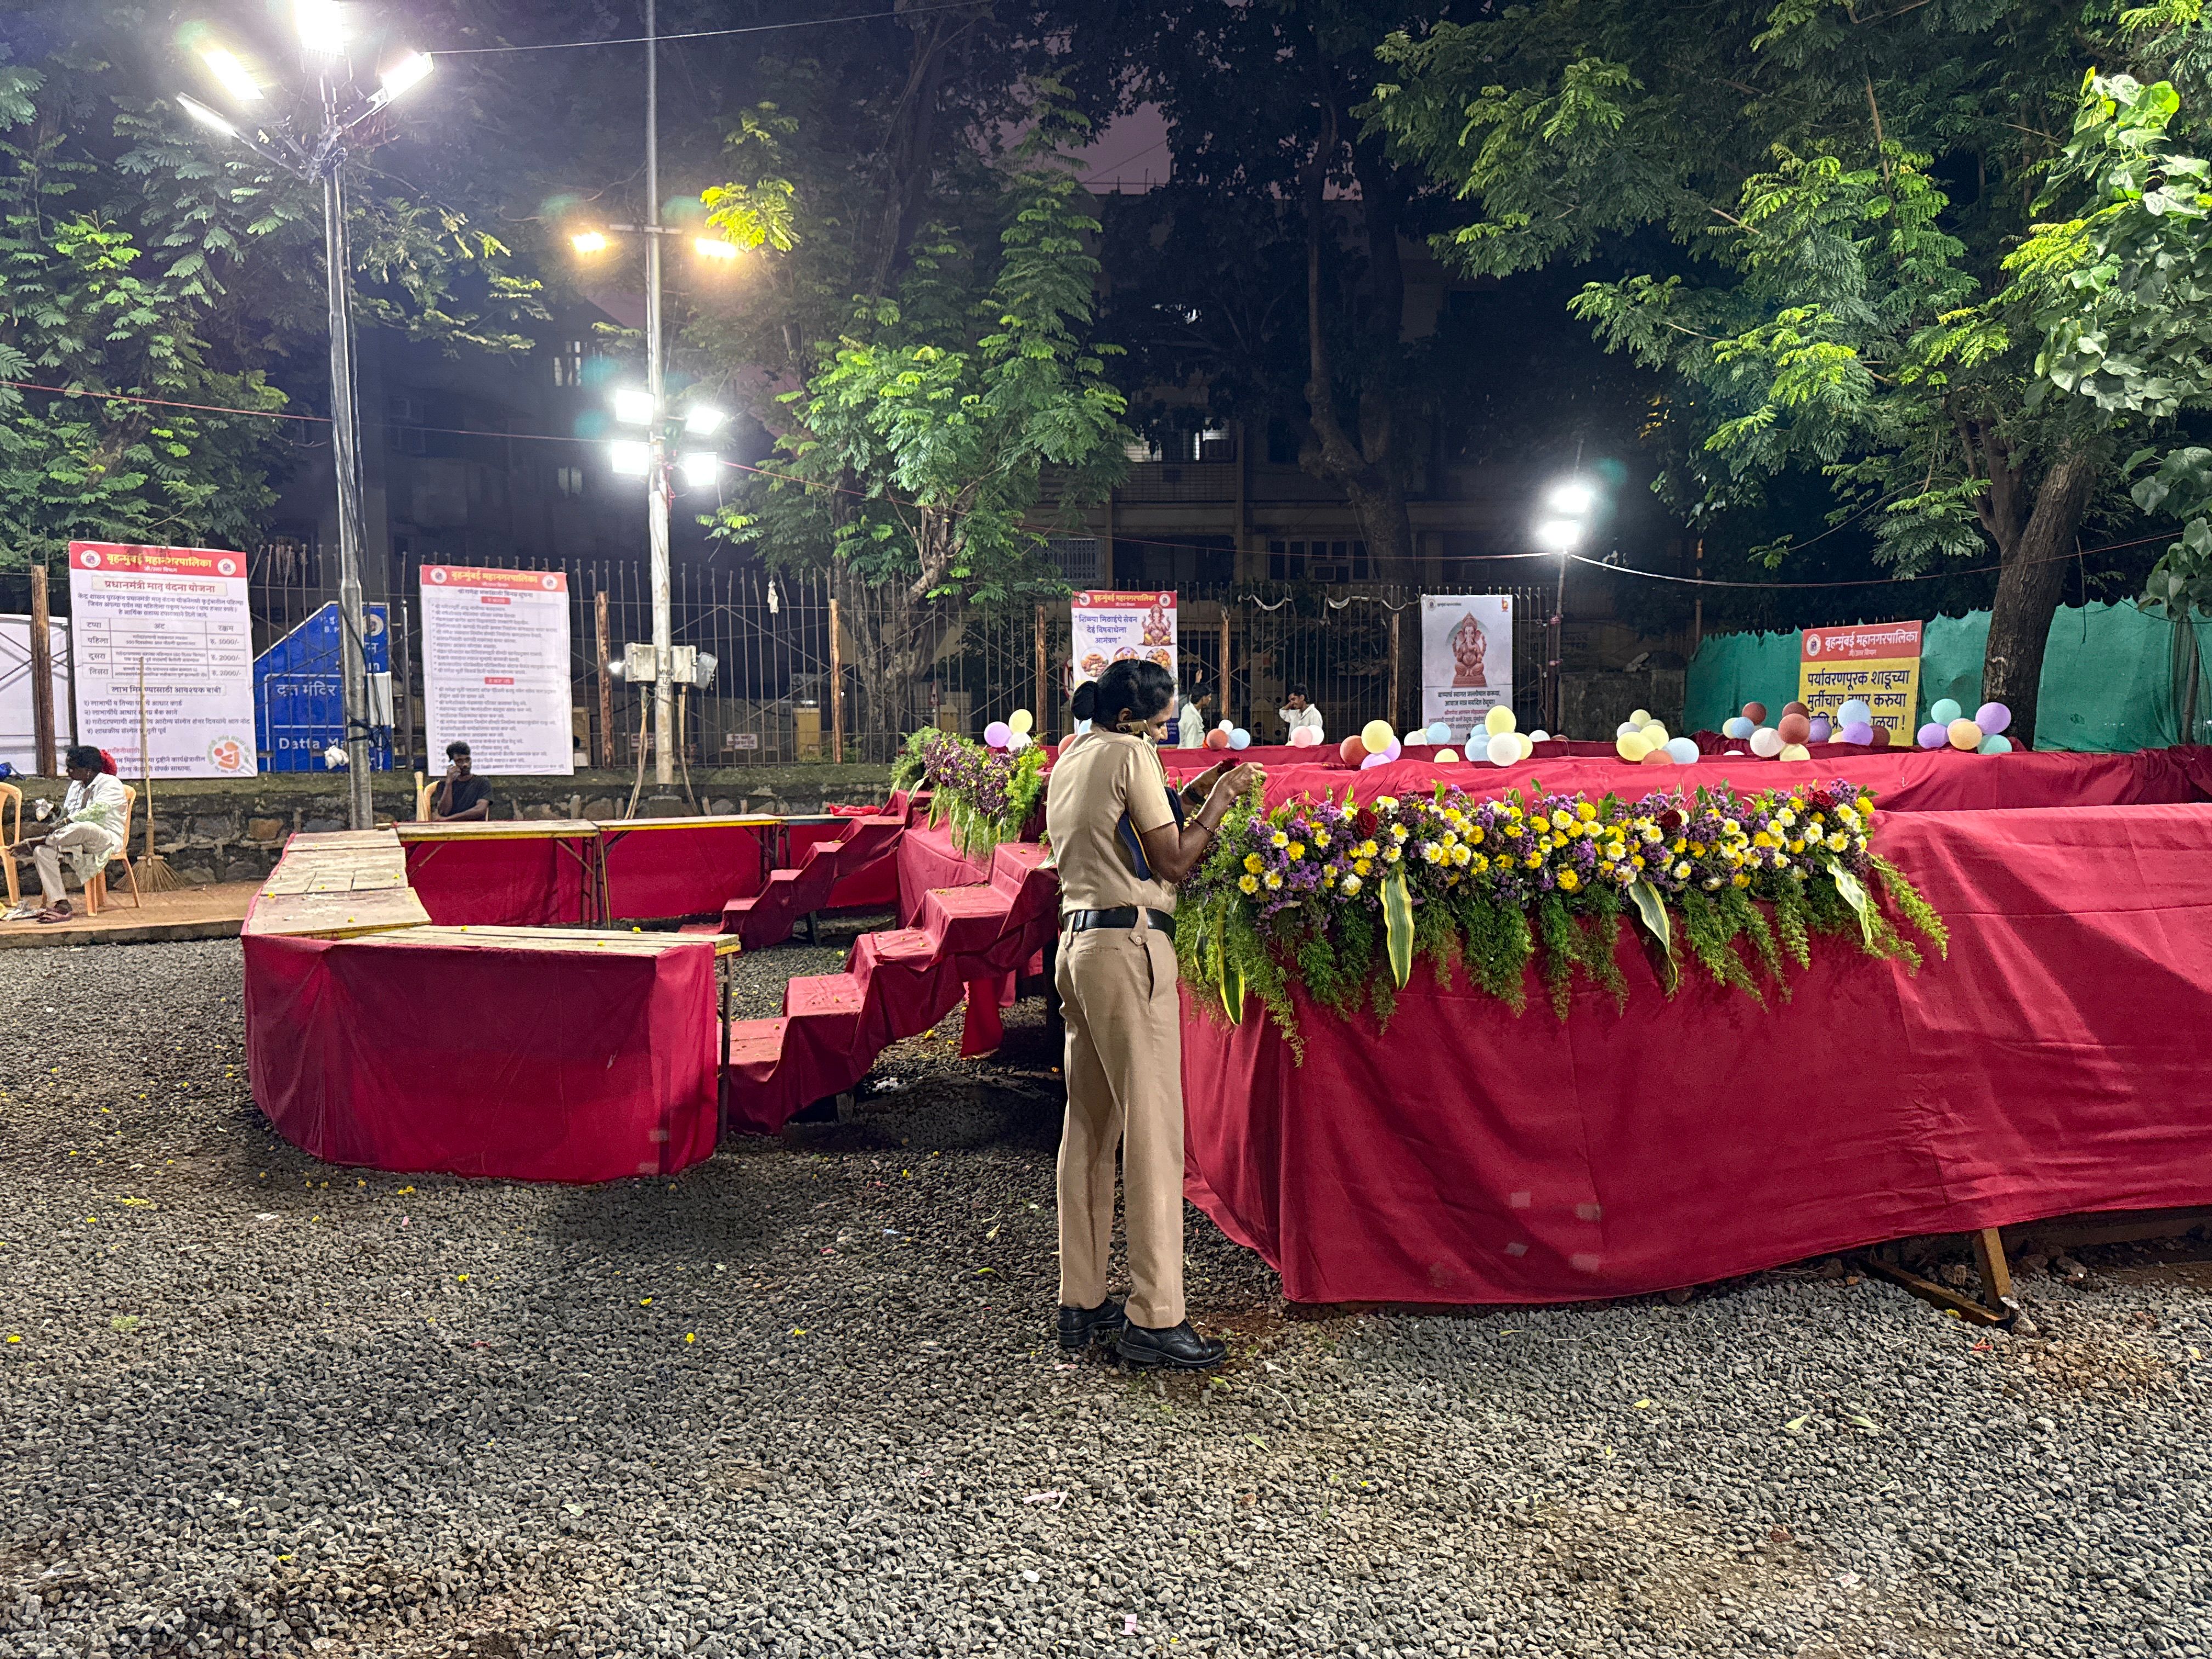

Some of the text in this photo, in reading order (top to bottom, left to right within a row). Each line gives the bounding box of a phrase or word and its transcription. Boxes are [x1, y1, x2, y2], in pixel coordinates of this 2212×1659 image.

[1116, 594, 1156, 602] महानगरपालिका
[1825, 629, 1918, 652] बृहन्मुंबई महानगरपालिका
[1808, 668, 1910, 691] पर्यावरणपूरक शाडूच्या
[1807, 690, 1845, 712] मुर्तीचाच
[1874, 693, 1907, 707] करुया
[279, 737, 320, 749] Datta
